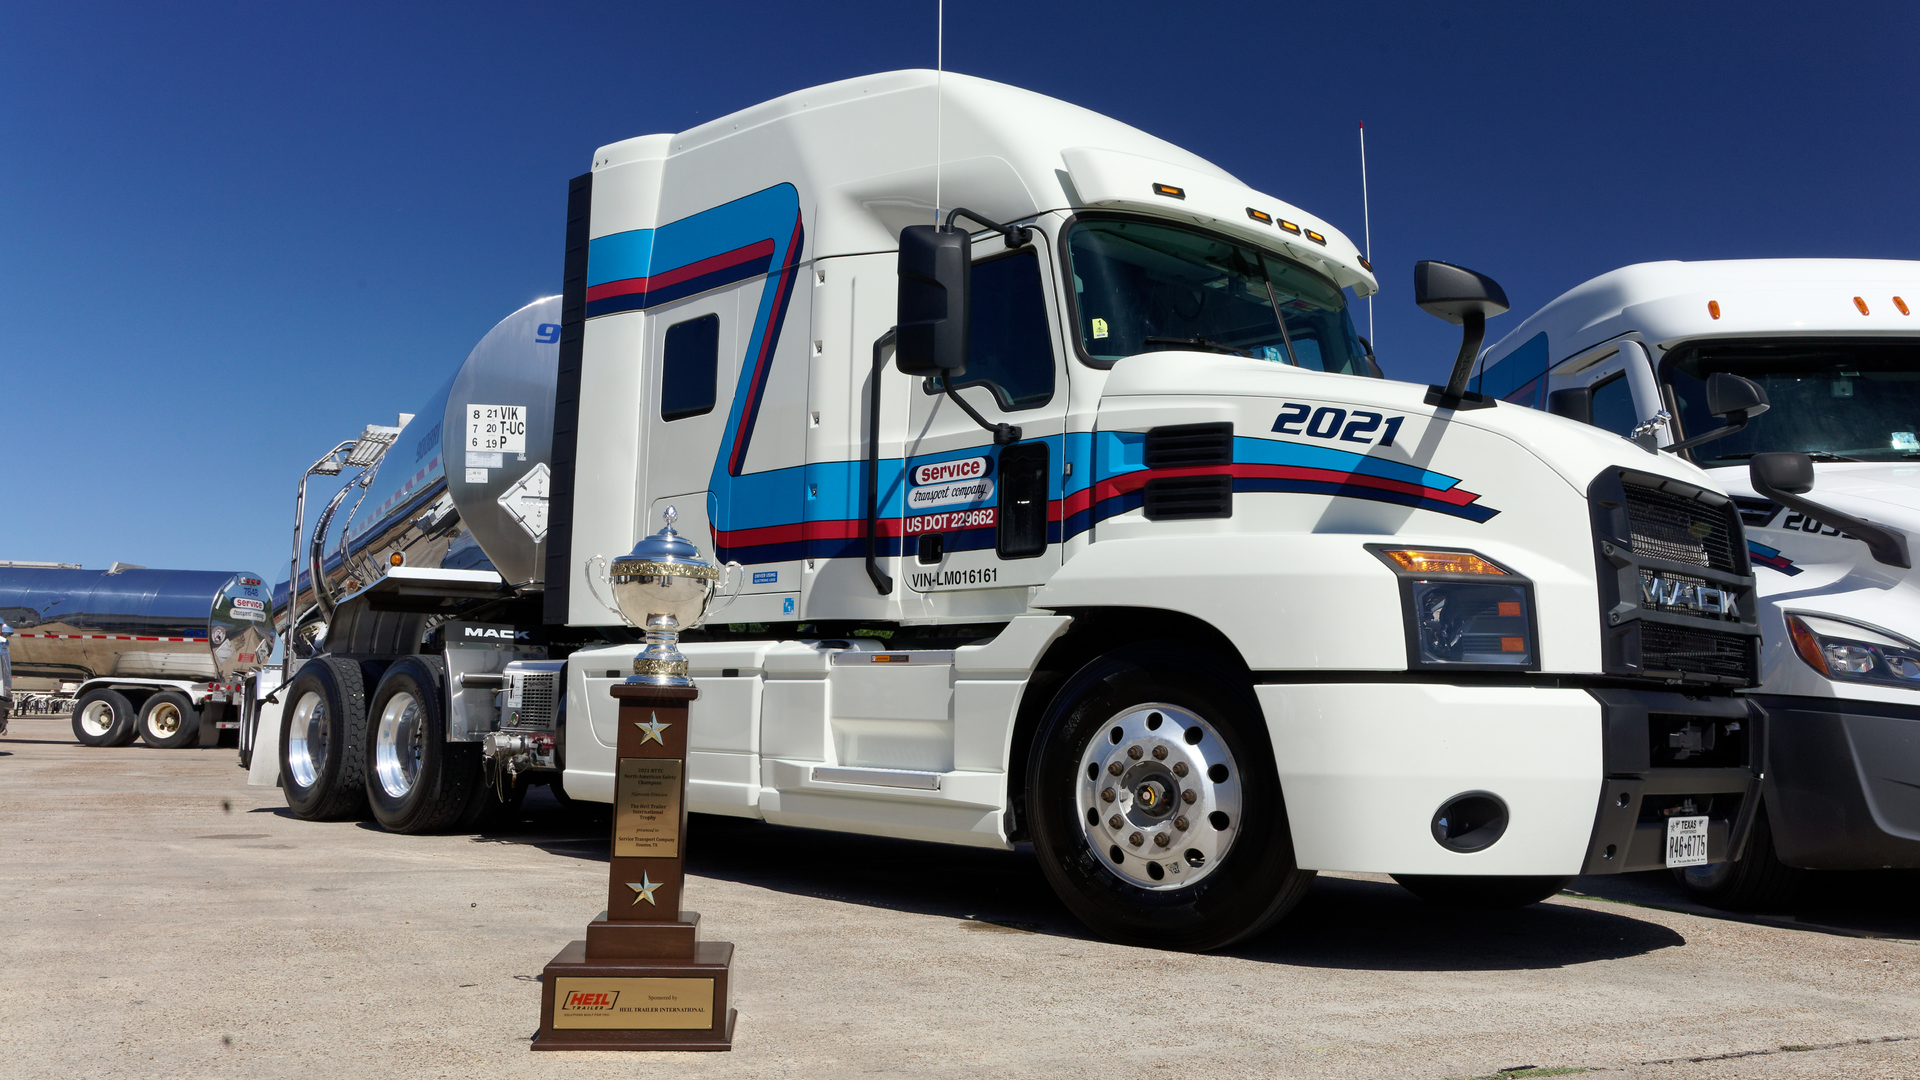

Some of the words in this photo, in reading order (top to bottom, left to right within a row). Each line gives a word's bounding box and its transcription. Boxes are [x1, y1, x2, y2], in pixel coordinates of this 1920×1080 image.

[473, 409, 480, 420] 8
[486, 409, 498, 418] 21
[500, 407, 518, 420] VIK
[473, 424, 478, 433] 7
[486, 424, 497, 433] 20
[500, 421, 525, 435] T-UC
[1271, 402, 1405, 447] 2021
[472, 437, 478, 447] 6
[486, 439, 497, 448] 19
[500, 436, 507, 449] P
[921, 460, 980, 482] service
[914, 486, 950, 503] transport
[951, 484, 988, 500] company
[906, 517, 922, 533] US
[924, 513, 950, 530] DOT
[951, 509, 994, 528] 229662
[912, 567, 998, 587] VIN-LM016161
[243, 588, 259, 597] 7848
[1639, 577, 1740, 616] MACK
[236, 600, 263, 609] service
[183, 628, 207, 638] 7848
[464, 627, 530, 639] MACK
[1681, 820, 1697, 829] TEXAS
[570, 993, 610, 1005] HEIL
